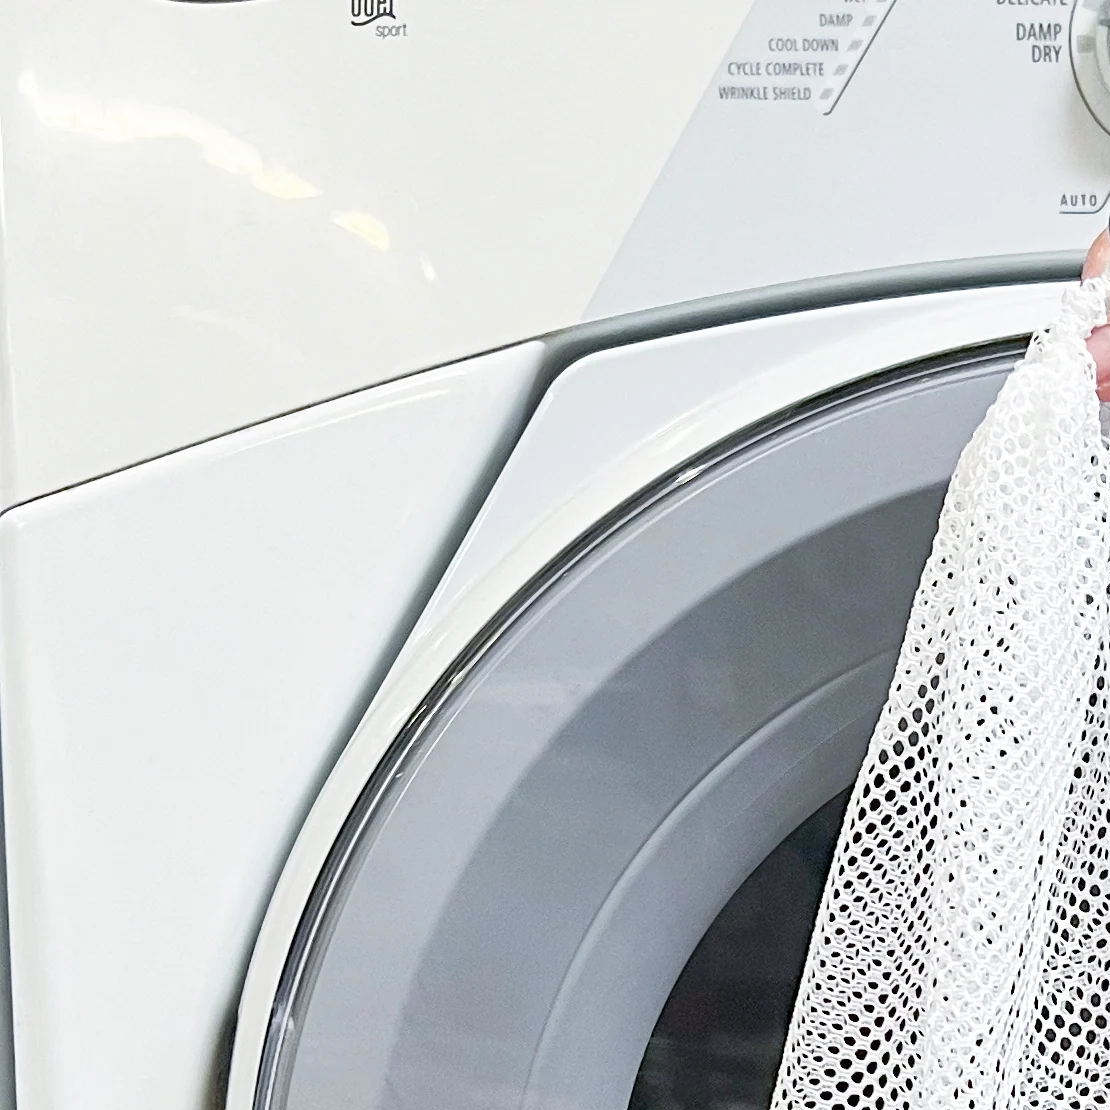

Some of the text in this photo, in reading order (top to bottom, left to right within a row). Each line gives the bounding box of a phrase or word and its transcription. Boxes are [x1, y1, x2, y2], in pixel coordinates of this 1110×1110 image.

[819, 13, 853, 27] DAMP
[375, 23, 407, 39] sport
[1016, 22, 1062, 41] DAMP
[768, 38, 839, 52] COOL DOWN
[1031, 44, 1062, 63] DRY
[727, 62, 824, 77] CYCLE COMPLETE
[719, 86, 812, 101] WRINKLE SHIELD
[1060, 194, 1097, 207] AUTO
